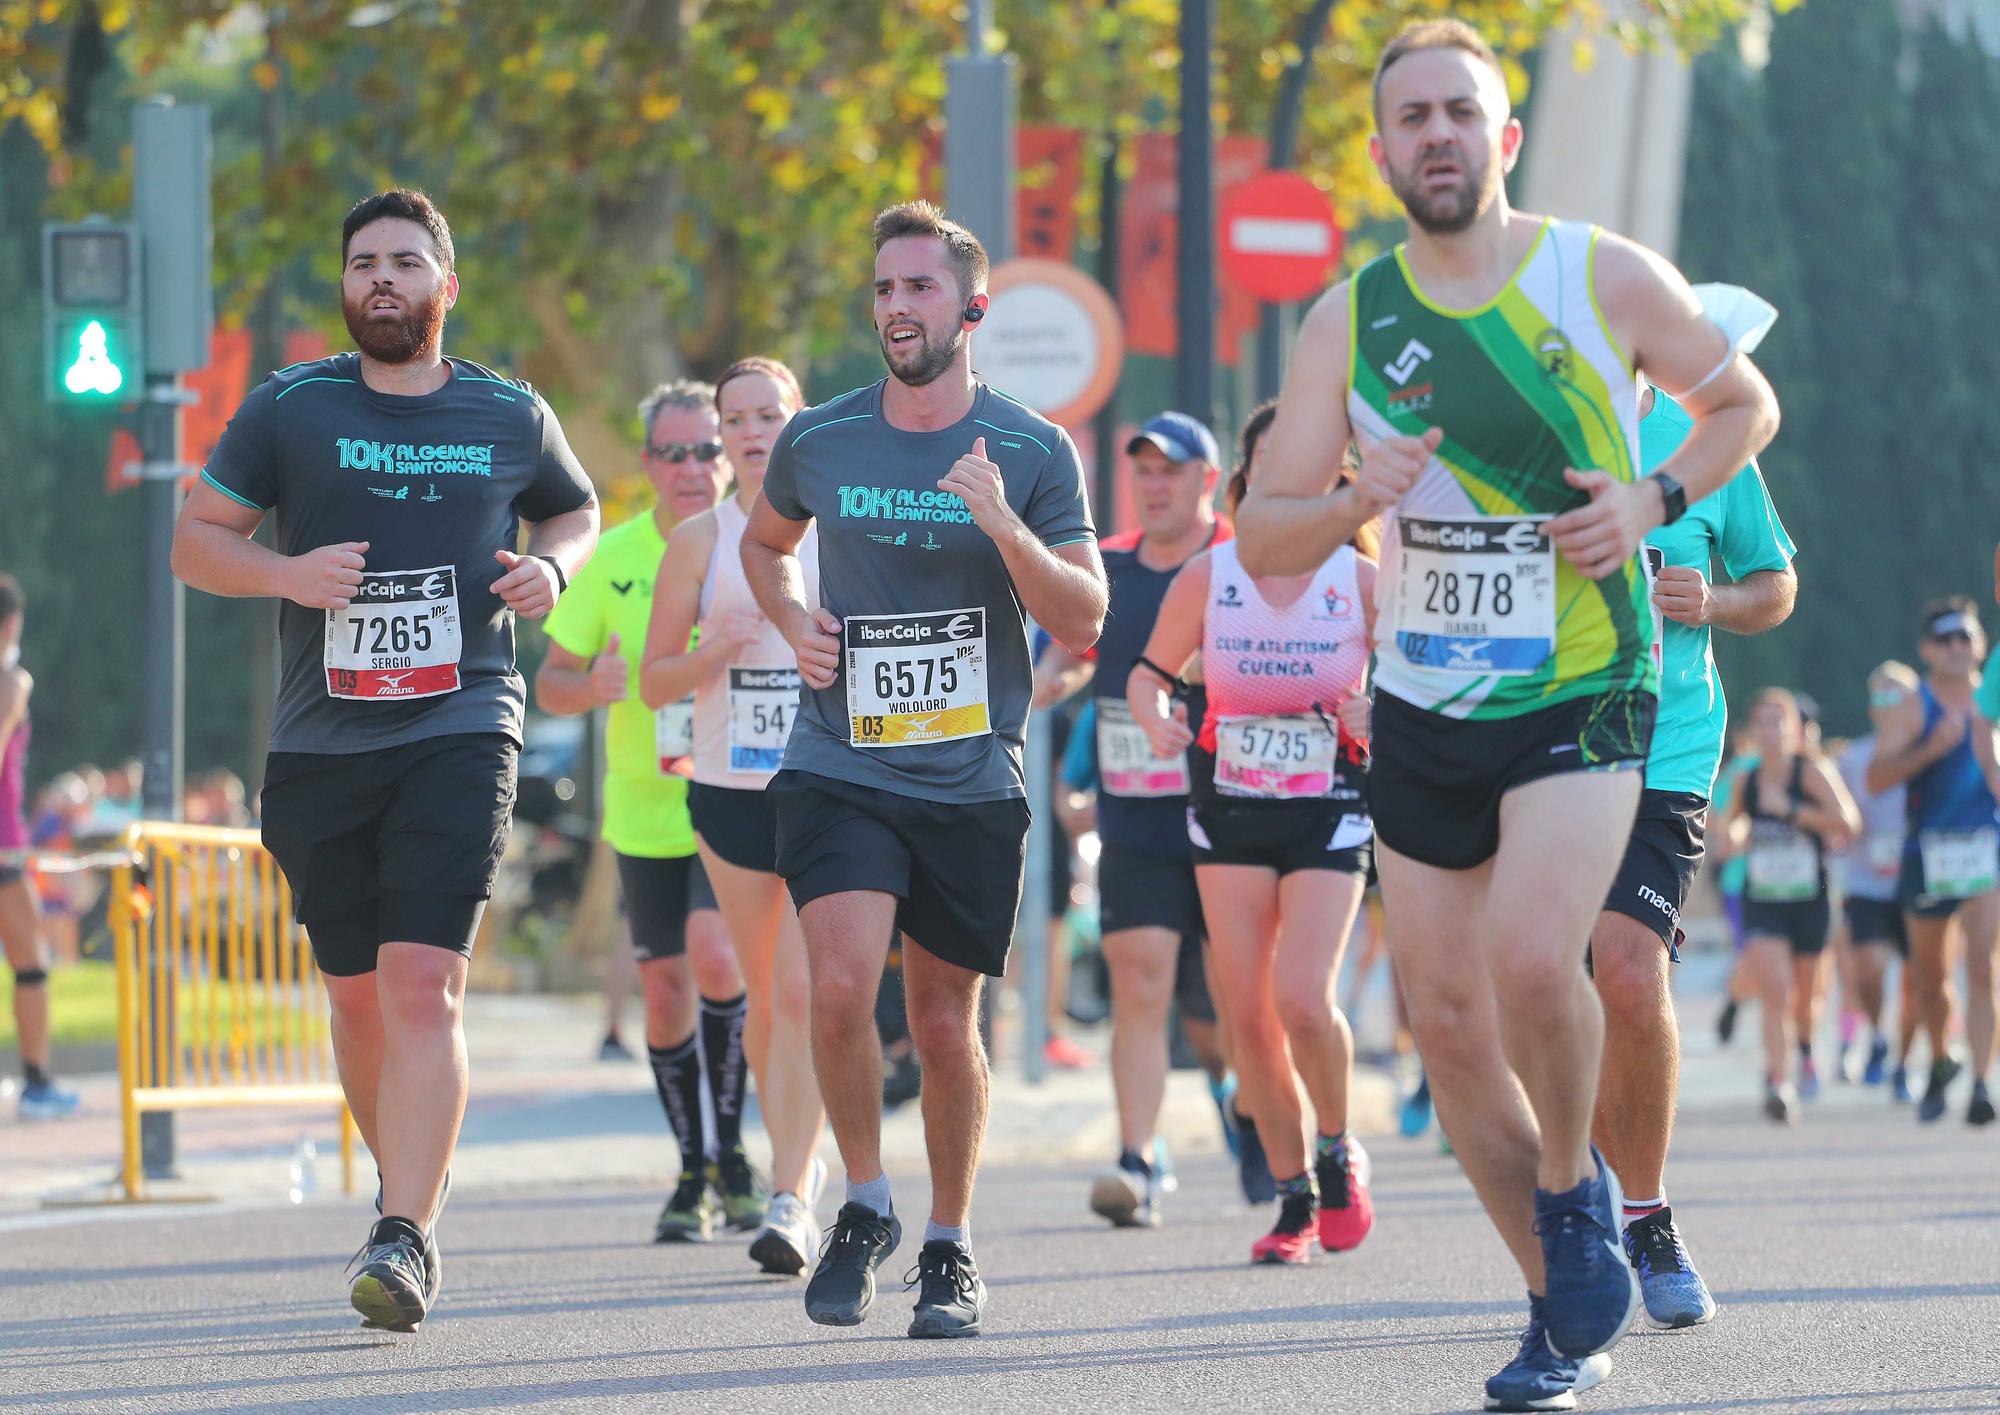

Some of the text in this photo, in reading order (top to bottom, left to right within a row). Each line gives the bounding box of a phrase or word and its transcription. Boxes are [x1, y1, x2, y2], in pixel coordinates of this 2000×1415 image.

[336, 437, 396, 474] 10K
[837, 486, 971, 519] 10K ALGEM
[894, 507, 977, 525] SANTONOF
[1409, 521, 1487, 551] iberCaja
[360, 581, 405, 600] rCaja
[1424, 569, 1514, 617] 2878
[348, 614, 432, 654] 7265
[860, 622, 932, 642] iberCaja
[1216, 638, 1252, 652] CLUB
[1405, 632, 1429, 657] 02
[371, 656, 411, 669] SERGIO
[1237, 659, 1314, 676] CUENCA
[338, 669, 358, 689] 03
[874, 655, 958, 699] 6575
[888, 697, 947, 714] WOLOLORD
[862, 715, 884, 736] 03
[1240, 725, 1308, 762] 5735
